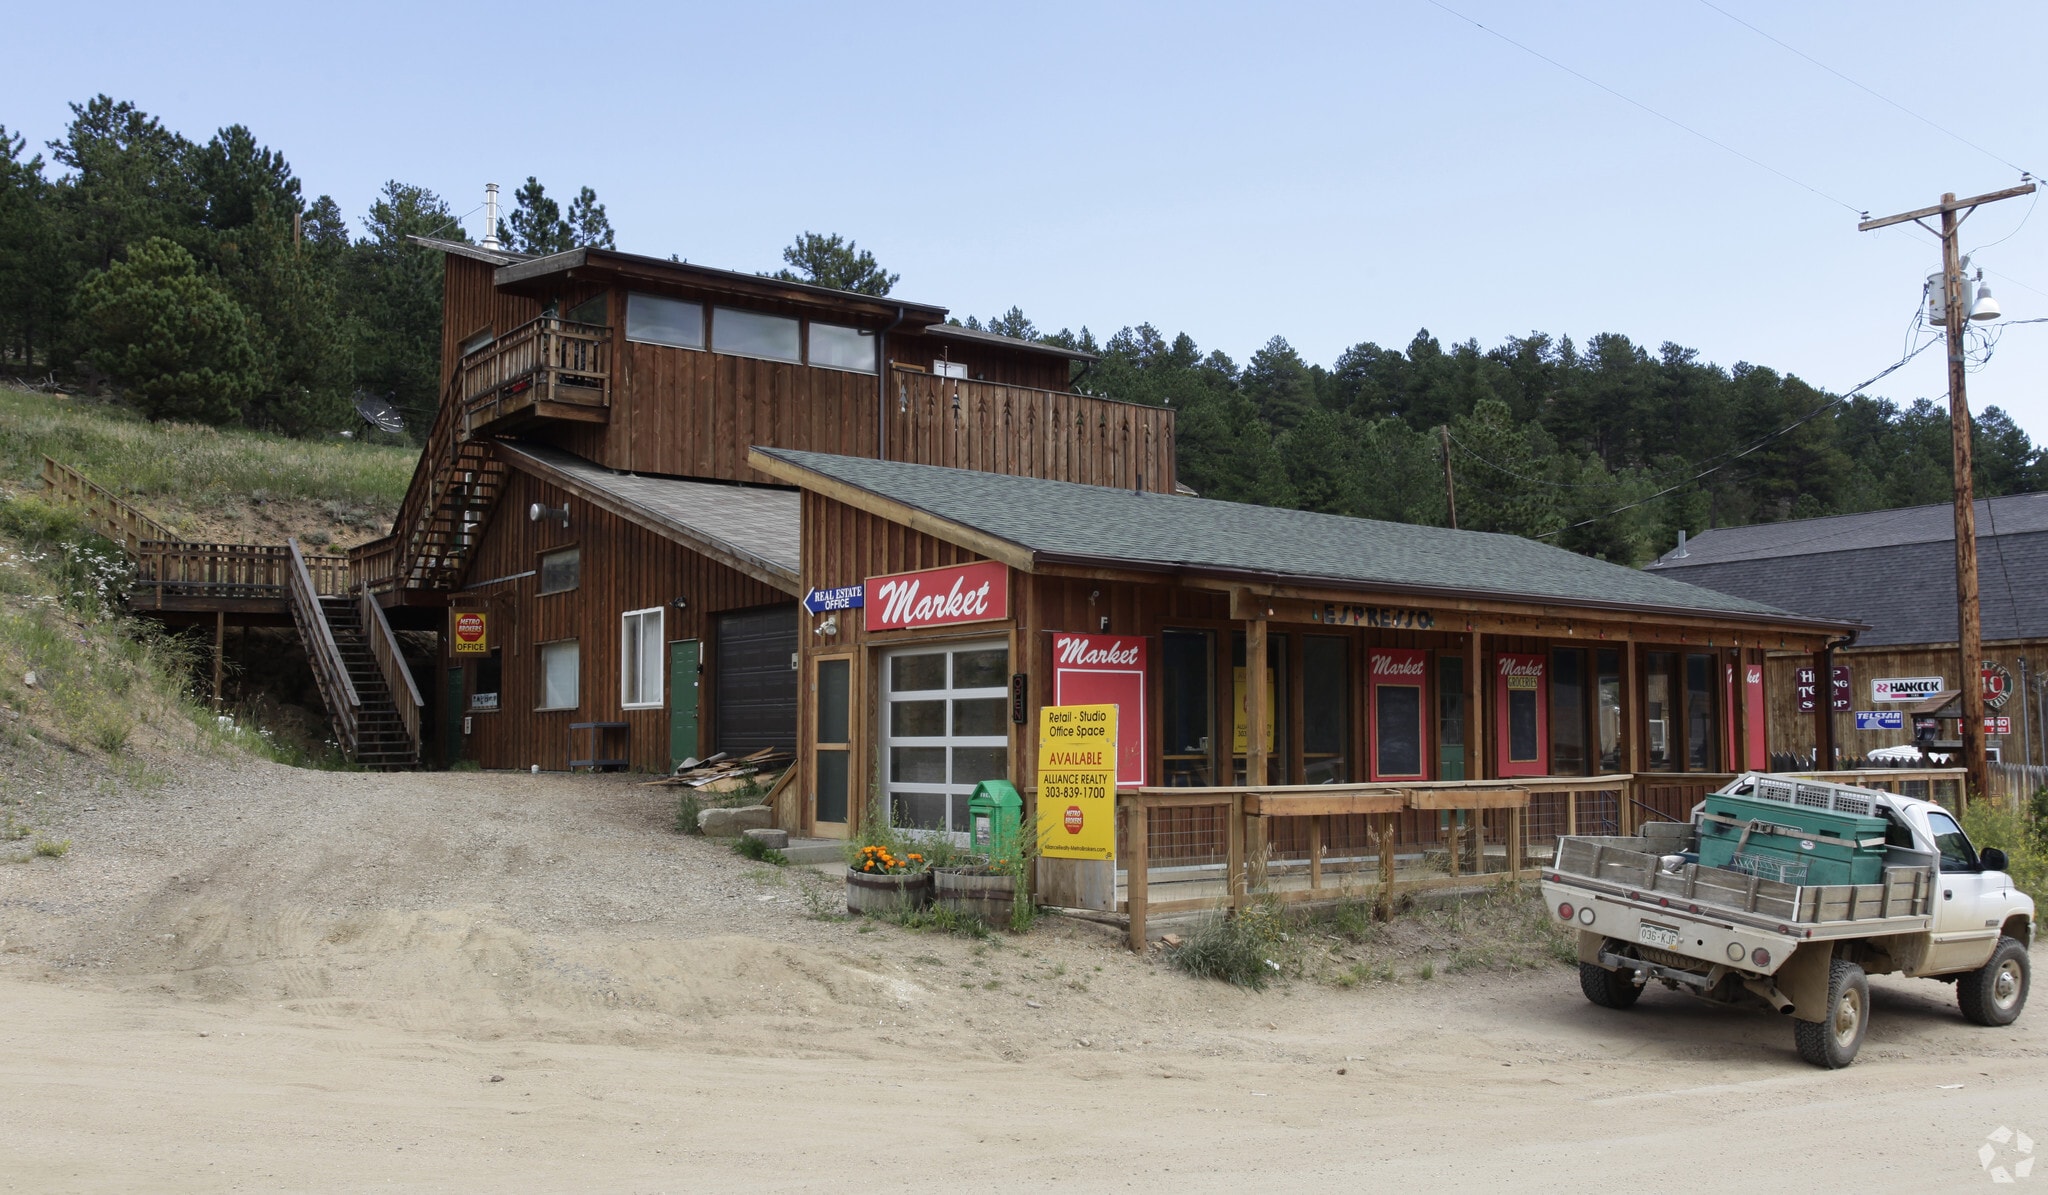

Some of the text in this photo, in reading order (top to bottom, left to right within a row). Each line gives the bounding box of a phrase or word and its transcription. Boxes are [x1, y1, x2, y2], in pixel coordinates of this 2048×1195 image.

[814, 586, 862, 602] REAL ESTATE
[879, 575, 990, 623] Market
[825, 598, 850, 610] OFFICE
[1324, 604, 1430, 629] ESPRESSO
[457, 643, 484, 651] OFFICE
[1057, 637, 1138, 665] Market
[1371, 654, 1424, 675] Market
[1499, 657, 1543, 676] Market
[1508, 676, 1537, 688] GROCERIES
[1890, 681, 1940, 692] HANKOOK
[1049, 712, 1072, 723] Retail
[1079, 710, 1107, 722] Studio
[1857, 712, 1901, 720] TELSTAR
[1049, 725, 1105, 738] Office Space
[1049, 752, 1102, 765] AVAILABLE
[1043, 774, 1107, 784] ALLIANCE REALTY
[1045, 786, 1105, 798] 303-839-1700
[1066, 809, 1081, 817] METRO
